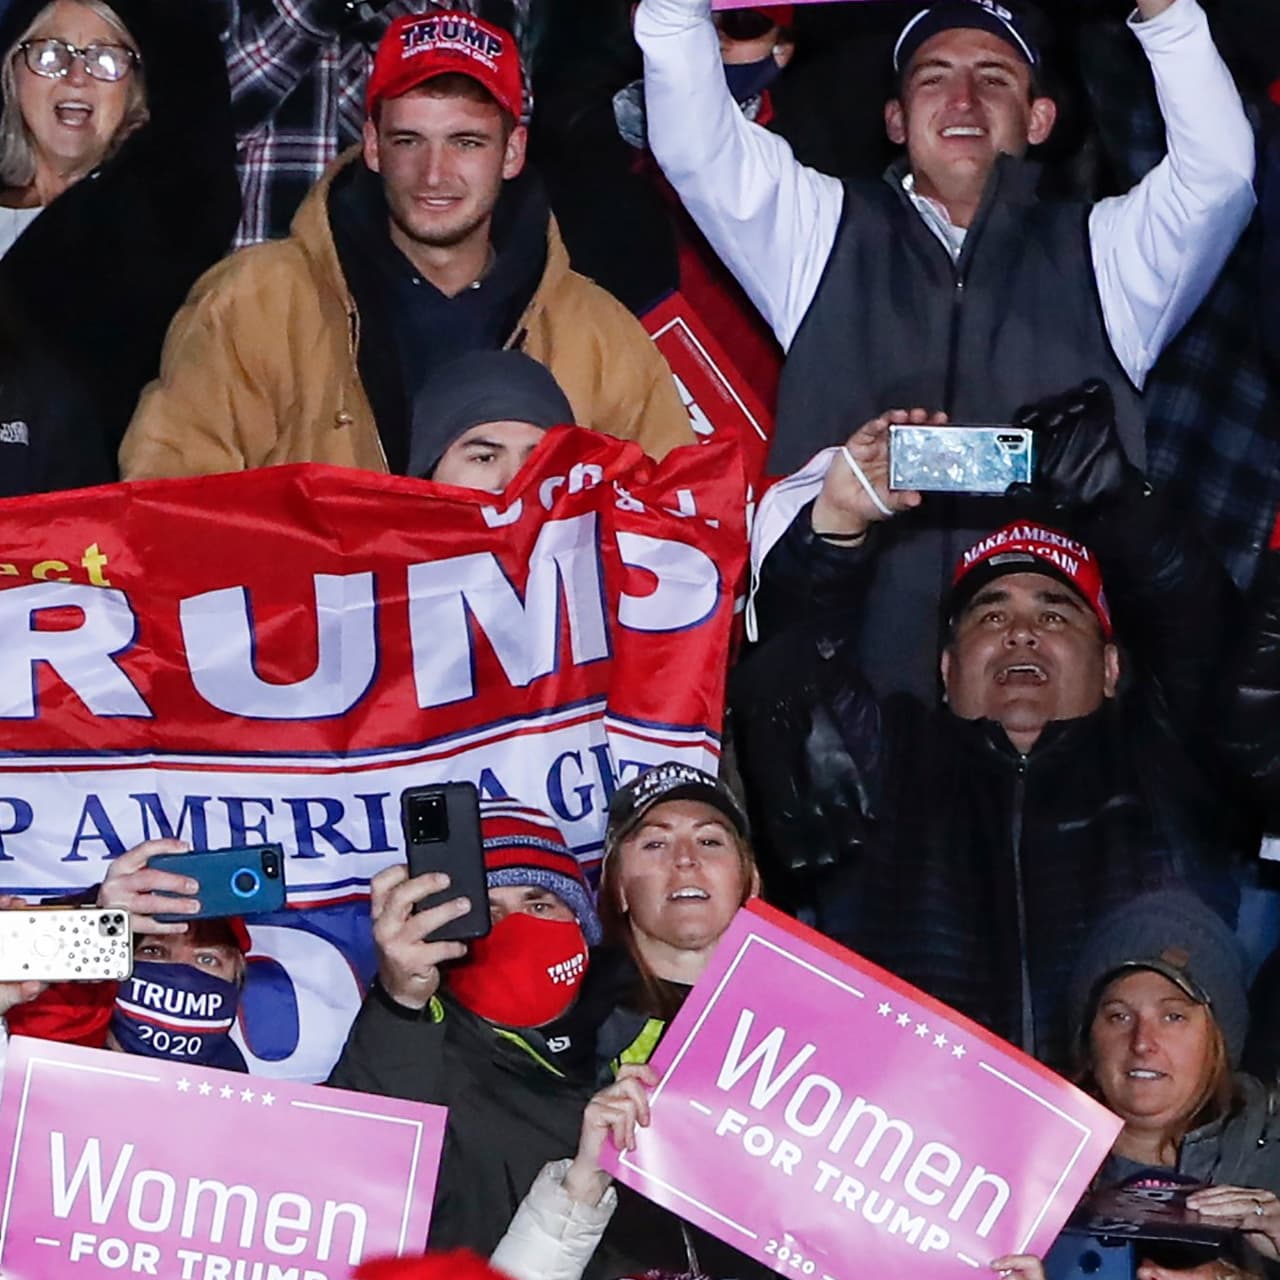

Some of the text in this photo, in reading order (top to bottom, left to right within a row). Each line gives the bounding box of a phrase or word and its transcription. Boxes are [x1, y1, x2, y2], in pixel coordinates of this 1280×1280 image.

[400, 25, 504, 58] TRUMP
[962, 526, 1090, 568] MAKE AMERICA
[630, 765, 715, 797] TRUMP
[547, 953, 584, 978] TRUMP
[130, 977, 223, 1017] TRUMP
[137, 1025, 202, 1055] 2020
[713, 1008, 1013, 1240] Women
[48, 1131, 368, 1266] Women
[715, 1107, 952, 1257] FOR TRUMP
[69, 1232, 159, 1275] FOR
[763, 1238, 818, 1275] 2020
